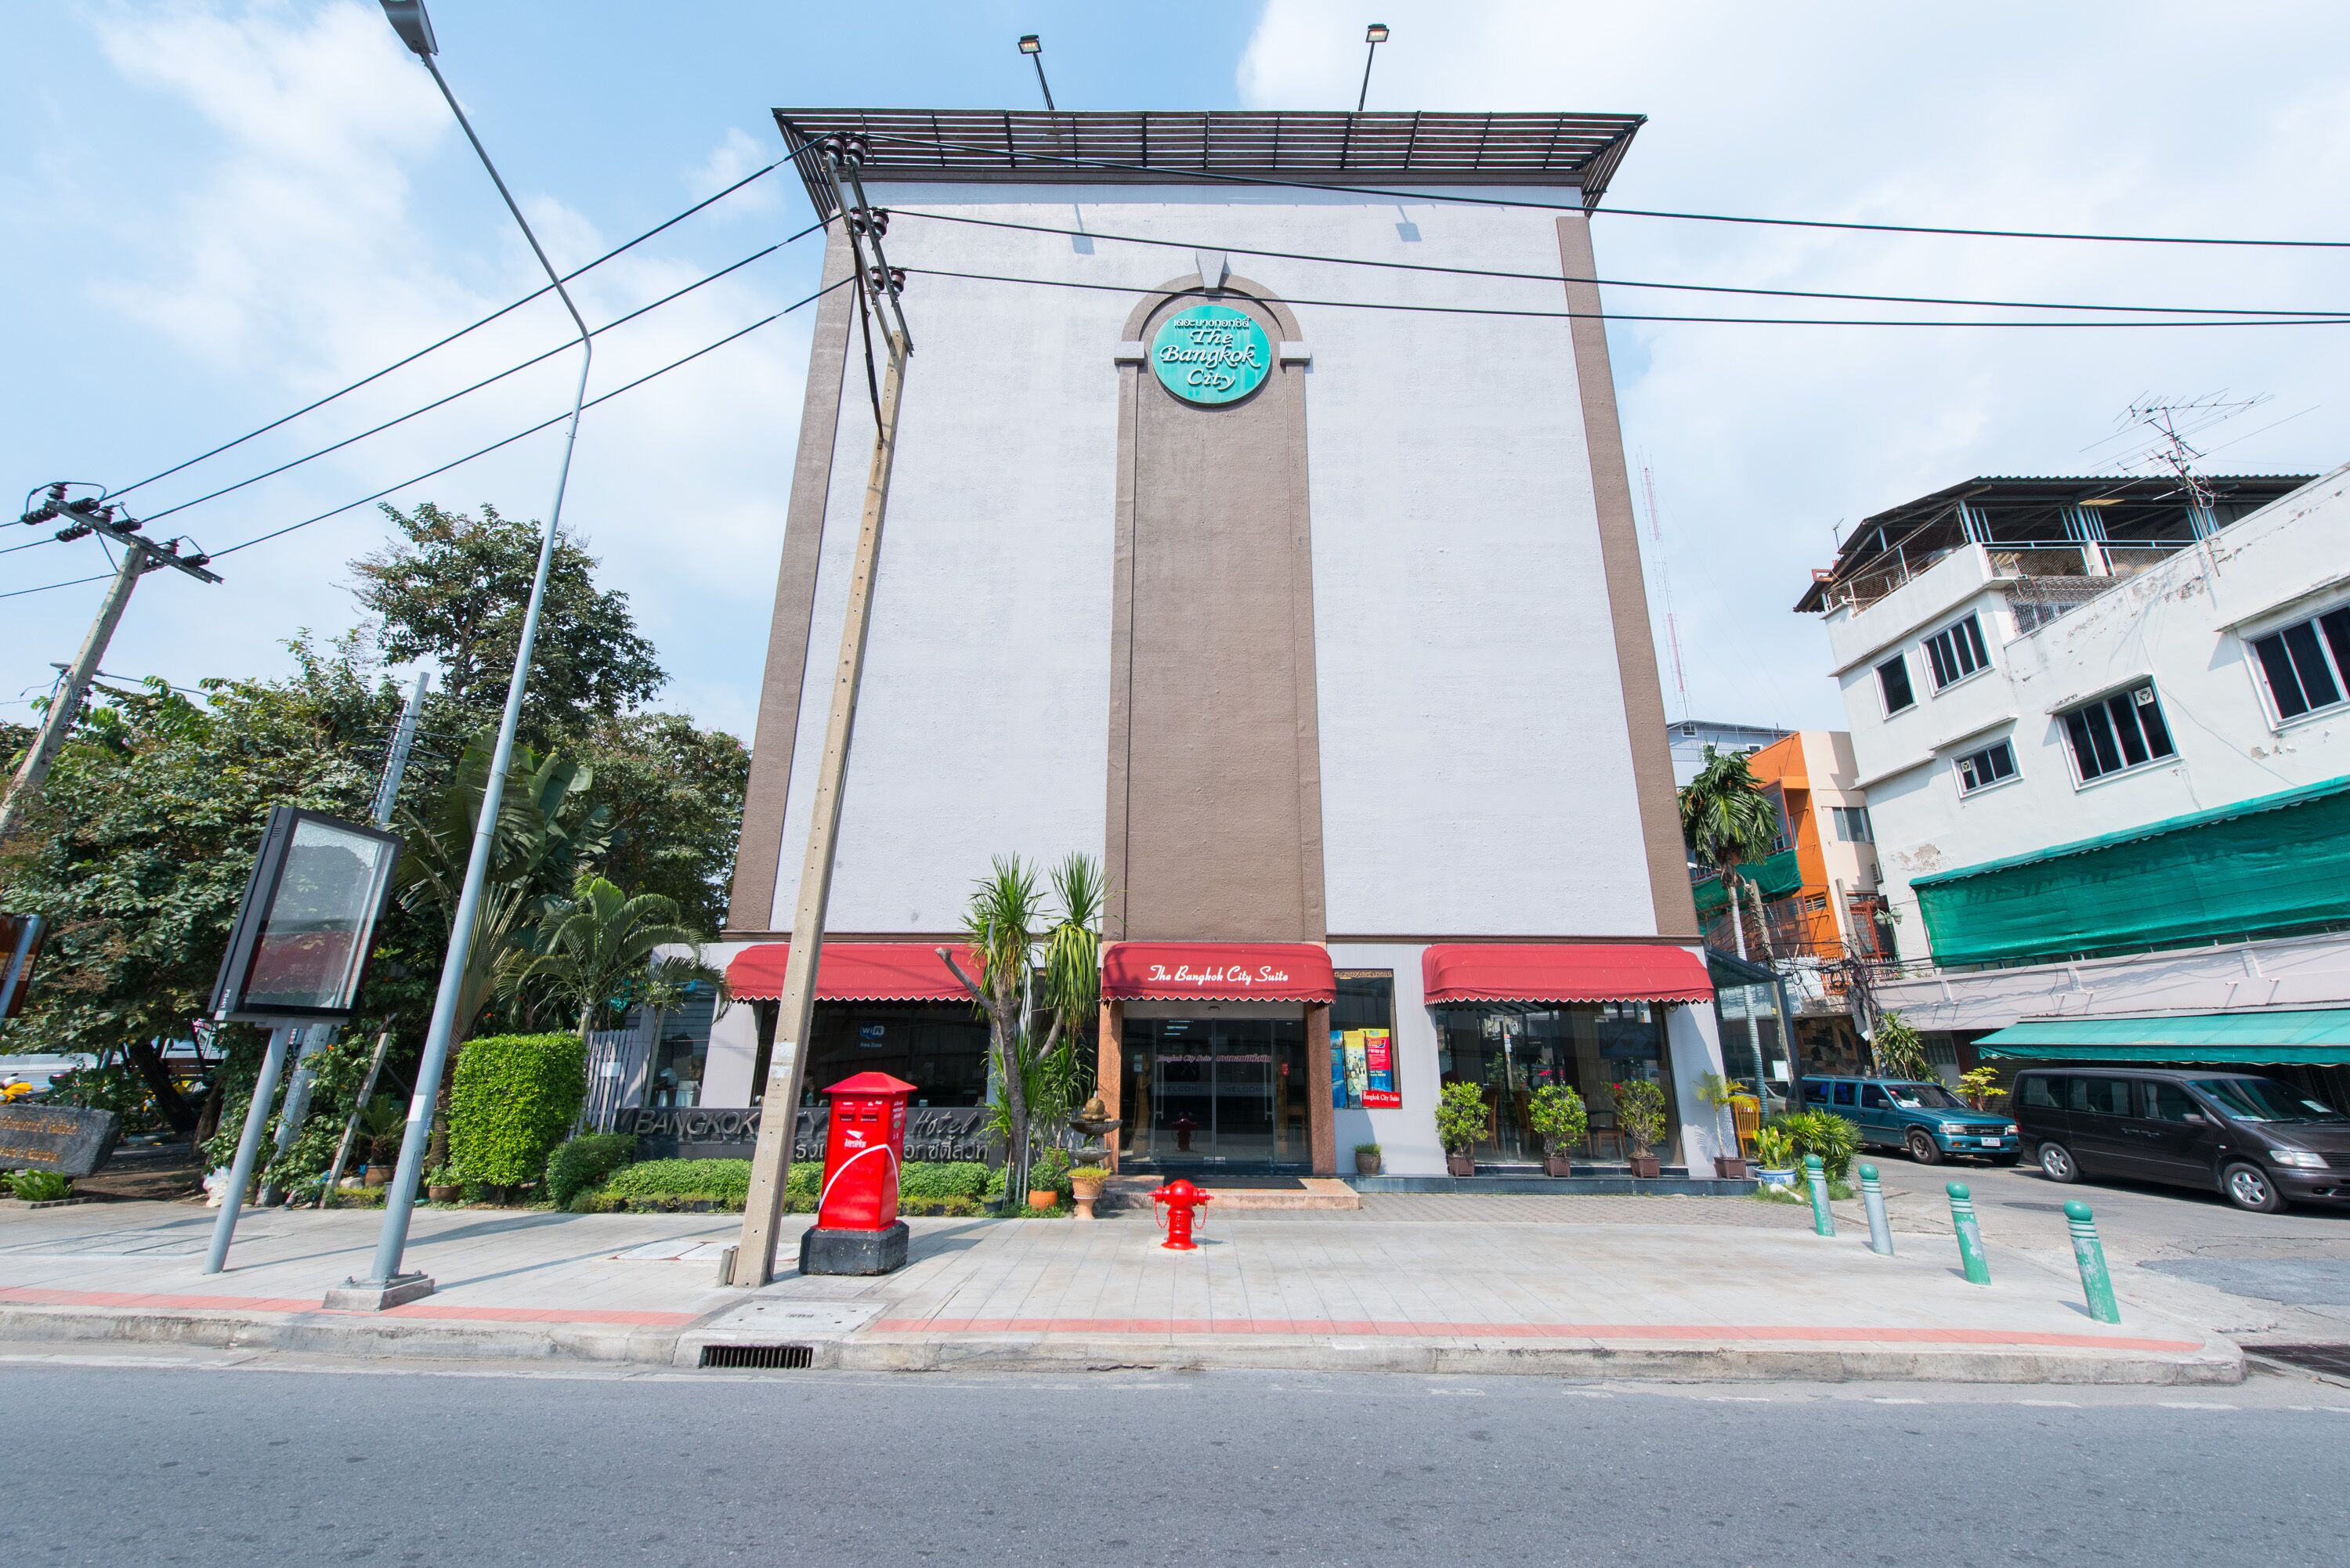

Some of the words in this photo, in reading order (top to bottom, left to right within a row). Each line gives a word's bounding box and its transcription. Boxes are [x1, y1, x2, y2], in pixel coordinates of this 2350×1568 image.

[1190, 330, 1233, 344] The
[1159, 344, 1260, 368] Bangkok
[1187, 369, 1235, 390] City
[1148, 965, 1171, 981] The
[1174, 965, 1223, 985] Bangkok
[1226, 966, 1252, 985] City
[1254, 966, 1289, 982] Suite
[1363, 1093, 1380, 1101] Bangkok
[634, 1109, 760, 1135] BANGKOK
[912, 1110, 978, 1136] Hotel
